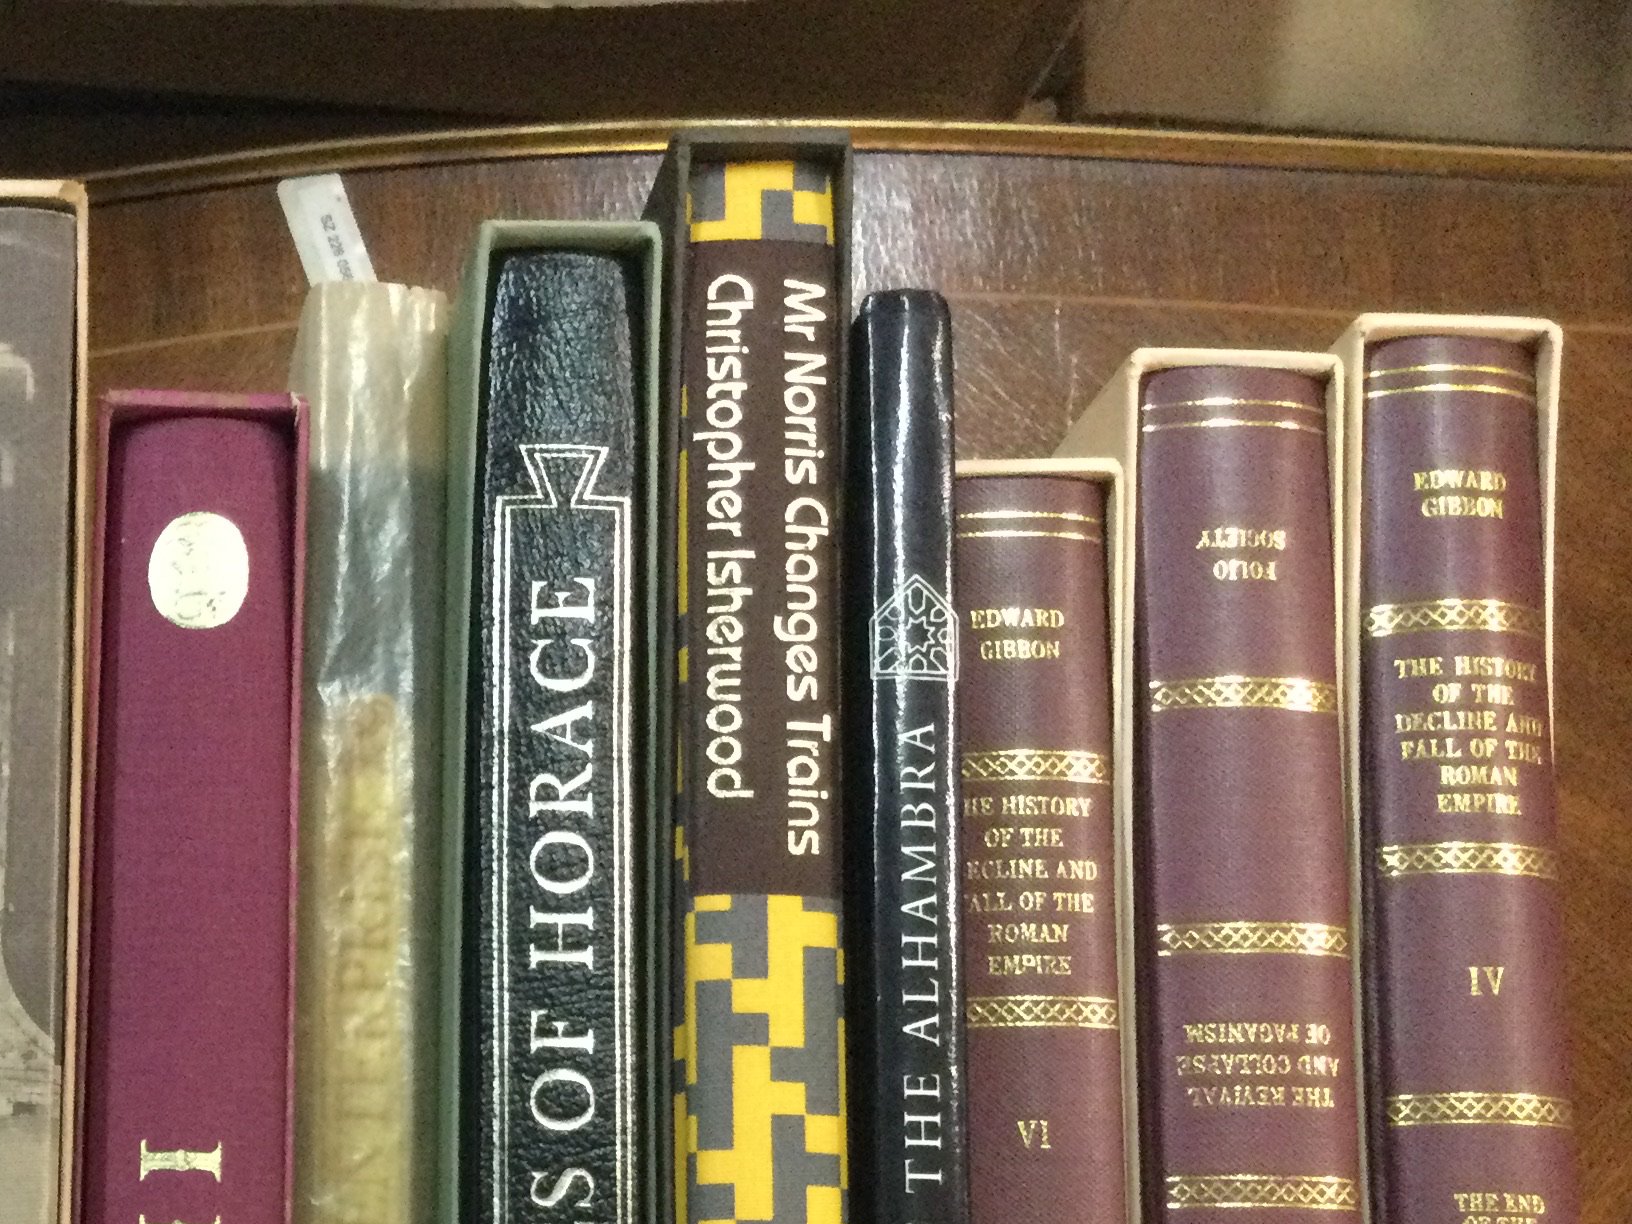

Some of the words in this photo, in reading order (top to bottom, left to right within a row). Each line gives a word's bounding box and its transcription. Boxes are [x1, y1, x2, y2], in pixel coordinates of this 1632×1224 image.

[783, 277, 828, 343] Mr
[693, 272, 756, 547] Christopher
[783, 353, 829, 485] Norris
[1413, 469, 1508, 492] EDWARD
[1421, 497, 1505, 520] GIBBON
[774, 496, 830, 703] Changes
[970, 606, 1066, 630] EDWARD
[979, 639, 1061, 662] GIBBON
[706, 549, 756, 800] Isherwood
[1393, 656, 1443, 679] THE
[1432, 682, 1462, 705] OF
[1471, 683, 1515, 706] THE
[1394, 710, 1498, 734] DECLINE
[1400, 738, 1462, 761] FALL
[1470, 738, 1498, 759] OF
[528, 577, 597, 971] HORACE
[786, 713, 832, 857] Trains
[1440, 765, 1519, 788] ROMAN
[1001, 795, 1092, 818] HISTORY
[1437, 793, 1522, 816] EMPIRE
[984, 828, 1015, 848] OF
[1019, 828, 1065, 848] THE
[1056, 860, 1099, 882] AND
[899, 720, 941, 1047] ALHAMBRA
[1018, 891, 1047, 912] OF
[1052, 891, 1095, 914] THE
[987, 923, 1070, 945] ROMAN
[1467, 965, 1506, 997] IV
[528, 1010, 596, 1132] OF
[902, 1072, 944, 1194] THE
[1017, 1119, 1052, 1149] VI
[139, 1138, 223, 1184] I
[1454, 1192, 1500, 1214] THE
[1504, 1192, 1547, 1215] END
